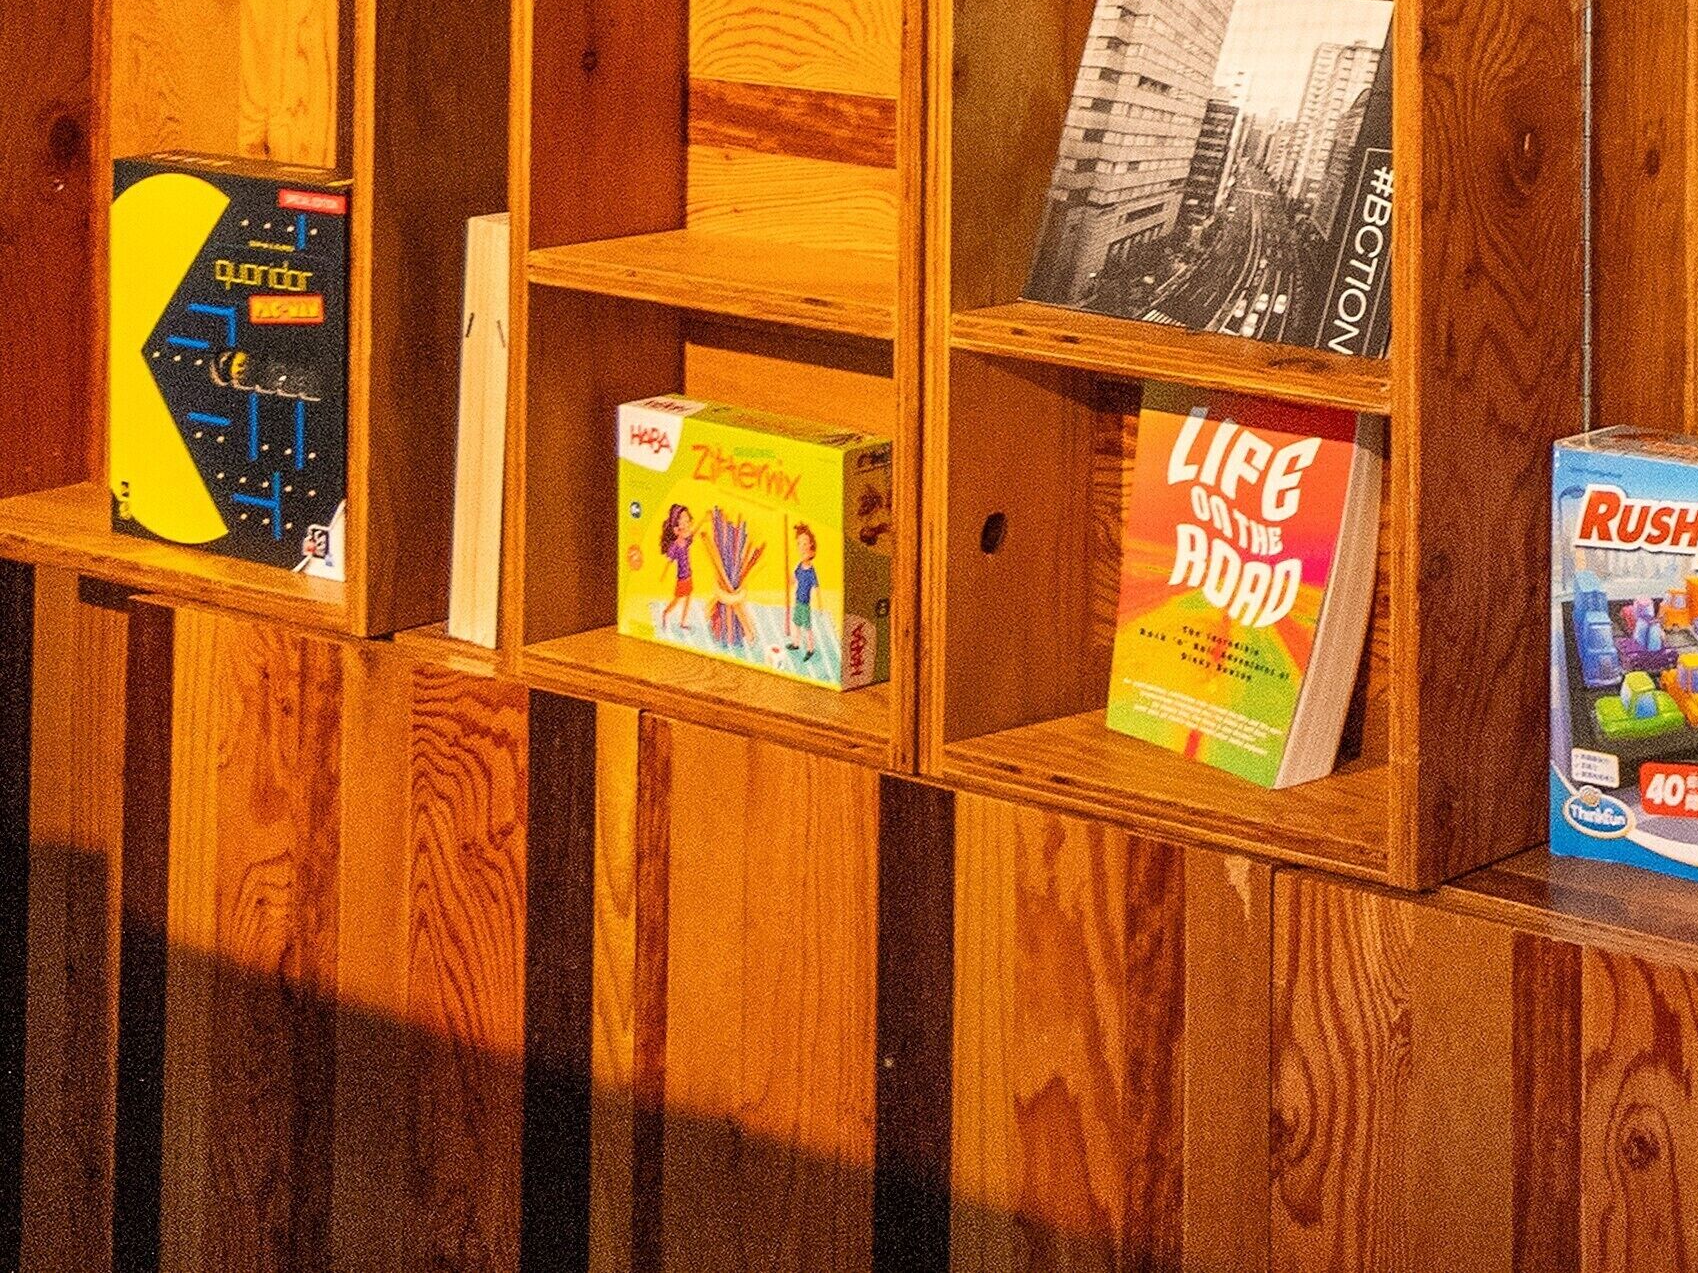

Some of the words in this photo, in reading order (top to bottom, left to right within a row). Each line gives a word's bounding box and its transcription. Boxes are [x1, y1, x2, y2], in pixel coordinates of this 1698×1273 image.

[215, 259, 313, 291] quoridor
[1329, 167, 1393, 355] #BCTION
[630, 423, 673, 454] HABA
[1167, 406, 1323, 522] LIFE
[1190, 486, 1234, 540] ON
[1232, 508, 1284, 557] THE
[1168, 522, 1302, 628] ROAD
[1645, 772, 1685, 807] 40
